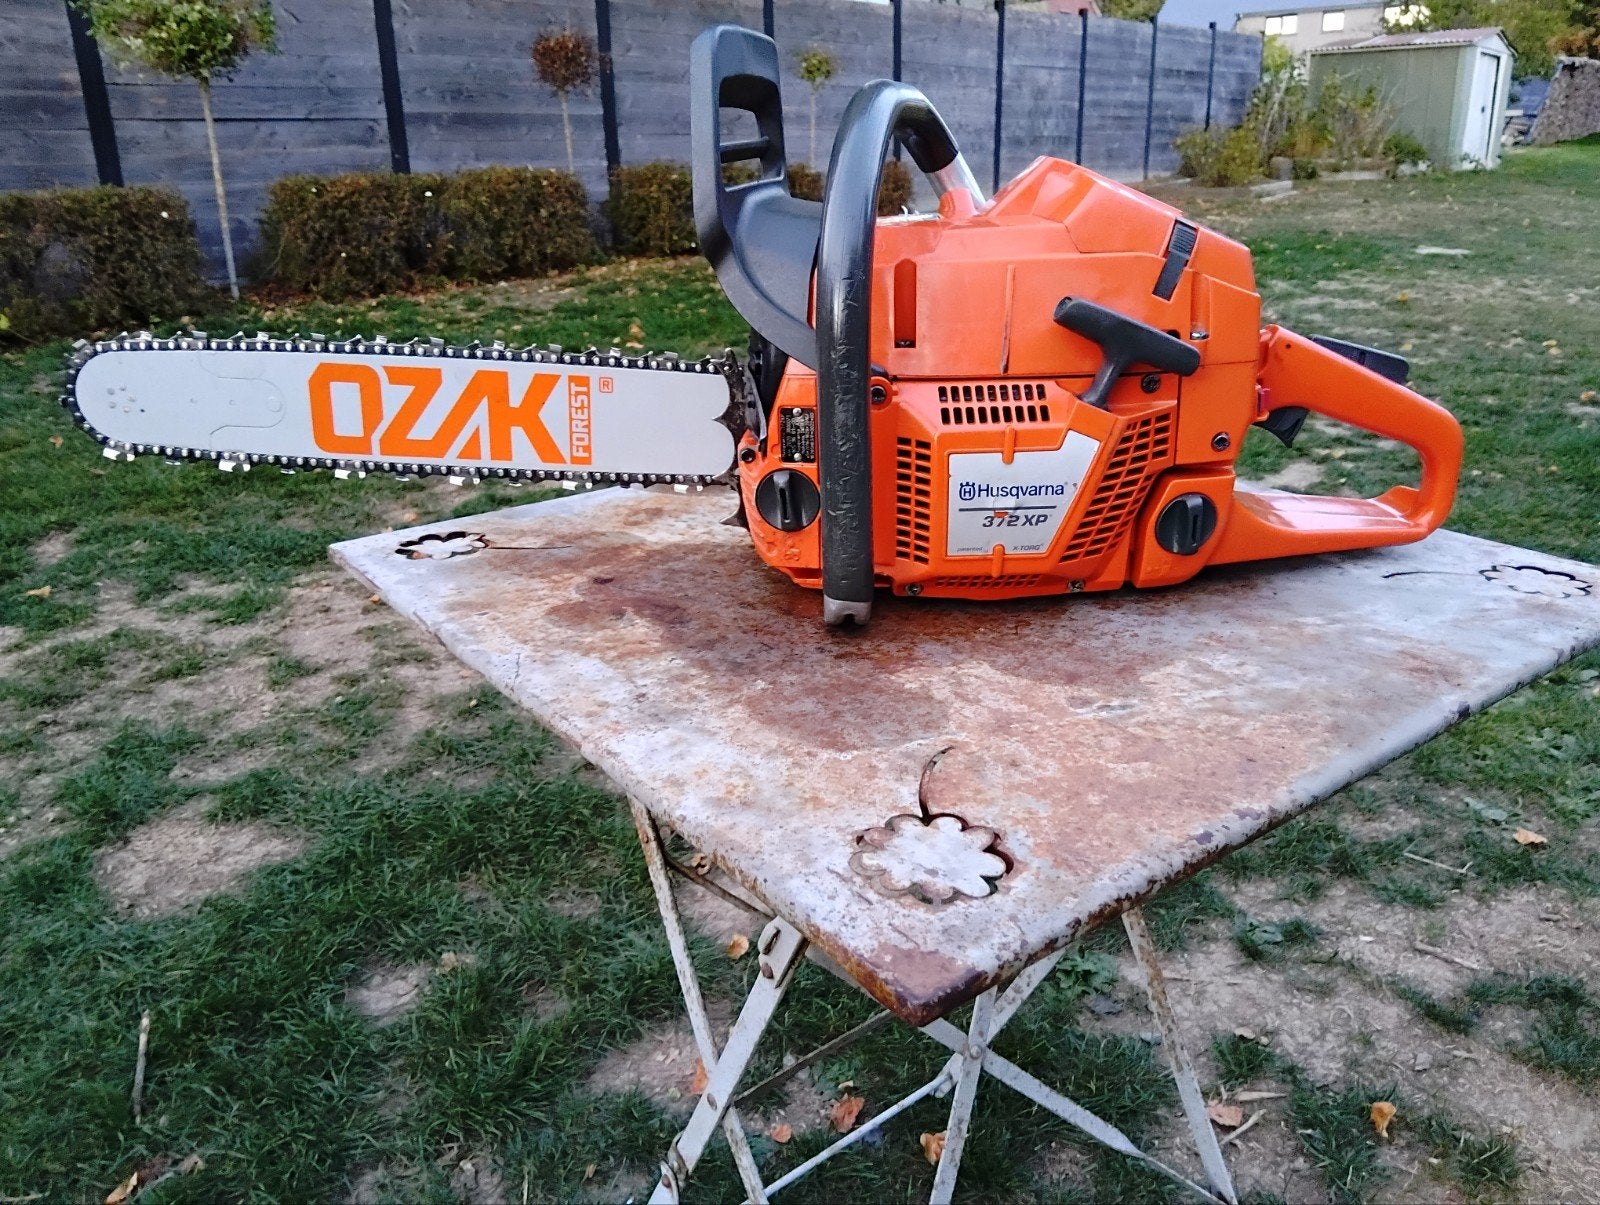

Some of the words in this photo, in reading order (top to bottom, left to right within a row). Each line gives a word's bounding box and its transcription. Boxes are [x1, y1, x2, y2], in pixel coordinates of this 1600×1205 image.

[308, 362, 567, 464] OZAK
[571, 382, 590, 458] FOREST
[978, 484, 1064, 499] Husqvarna
[982, 515, 1020, 528] 372
[1021, 514, 1048, 527] XP
